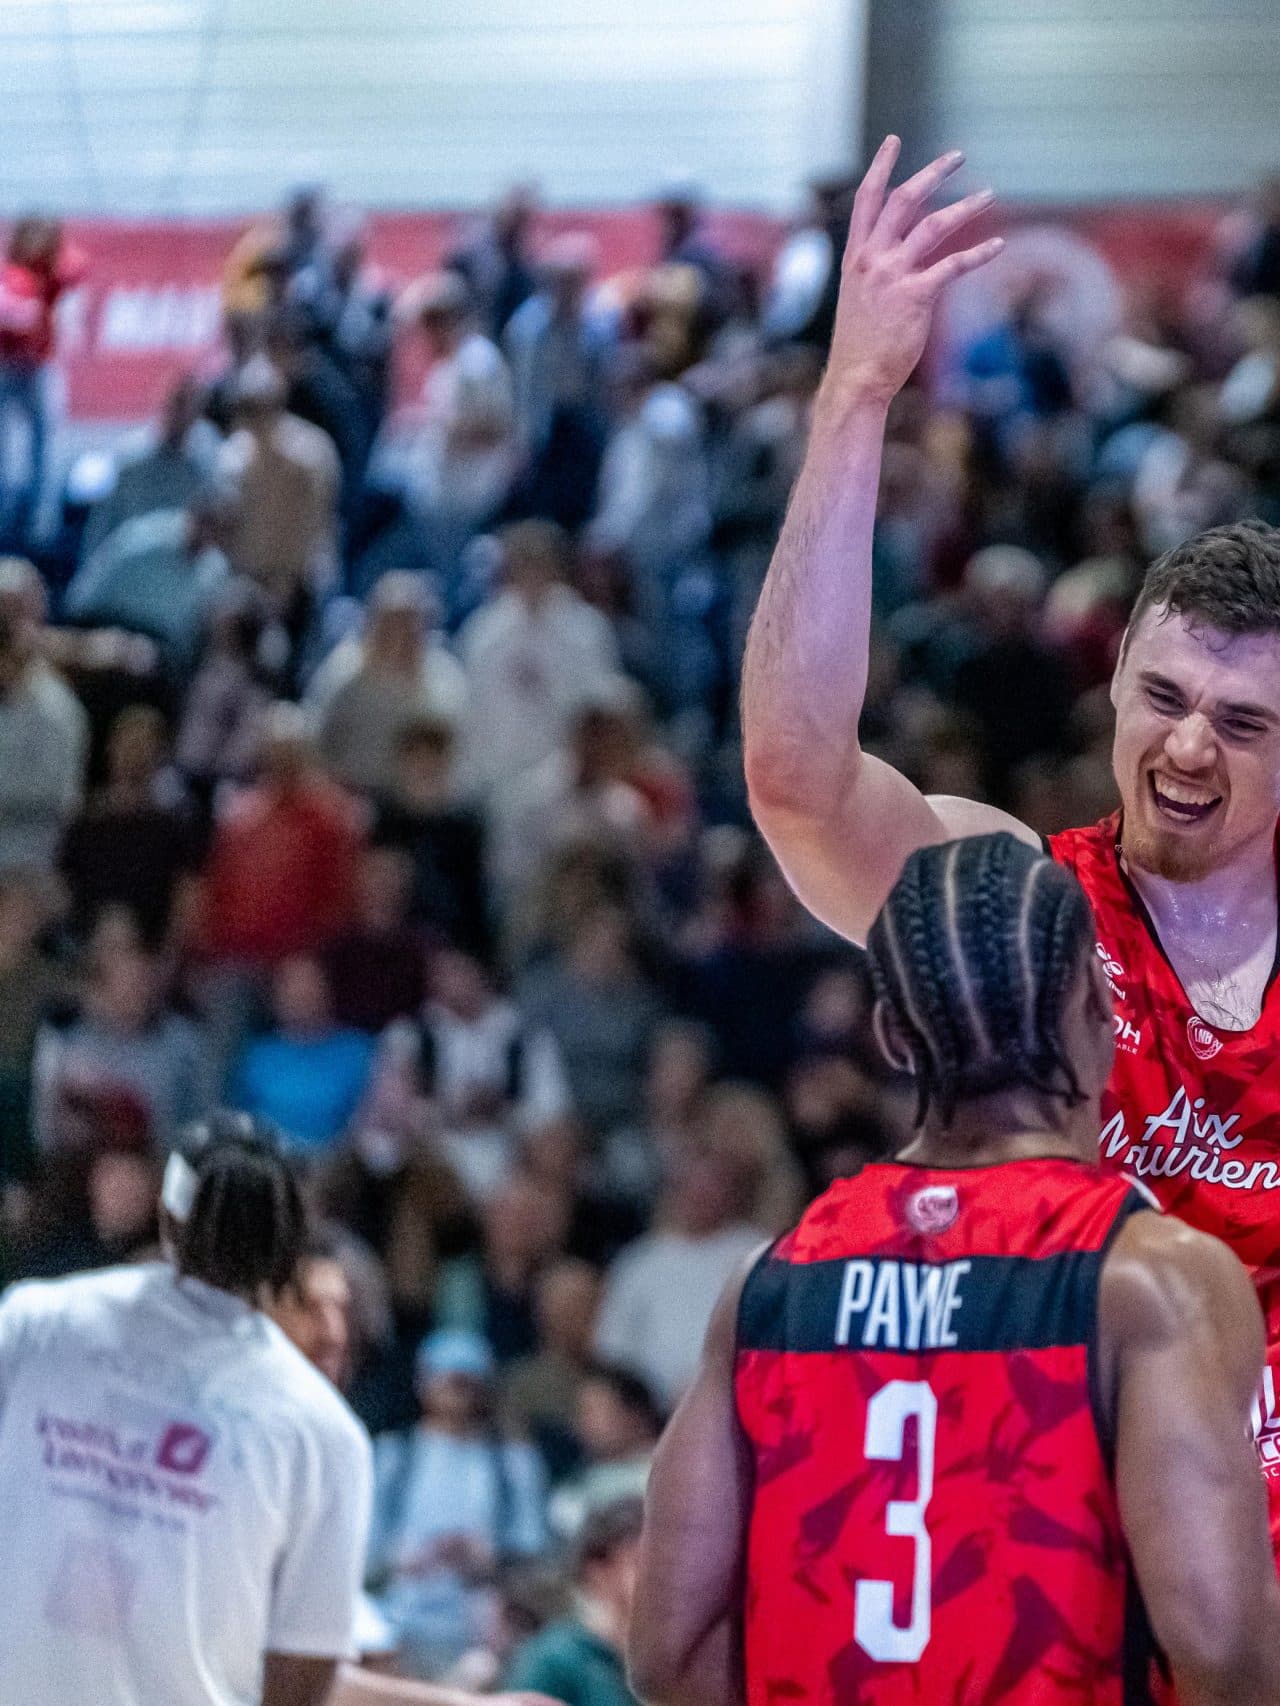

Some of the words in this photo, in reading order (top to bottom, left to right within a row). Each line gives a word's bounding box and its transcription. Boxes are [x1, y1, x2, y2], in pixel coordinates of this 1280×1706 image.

[1143, 1085, 1243, 1149] Aix
[834, 1259, 971, 1350] PAYNE
[854, 1379, 938, 1662] 3
